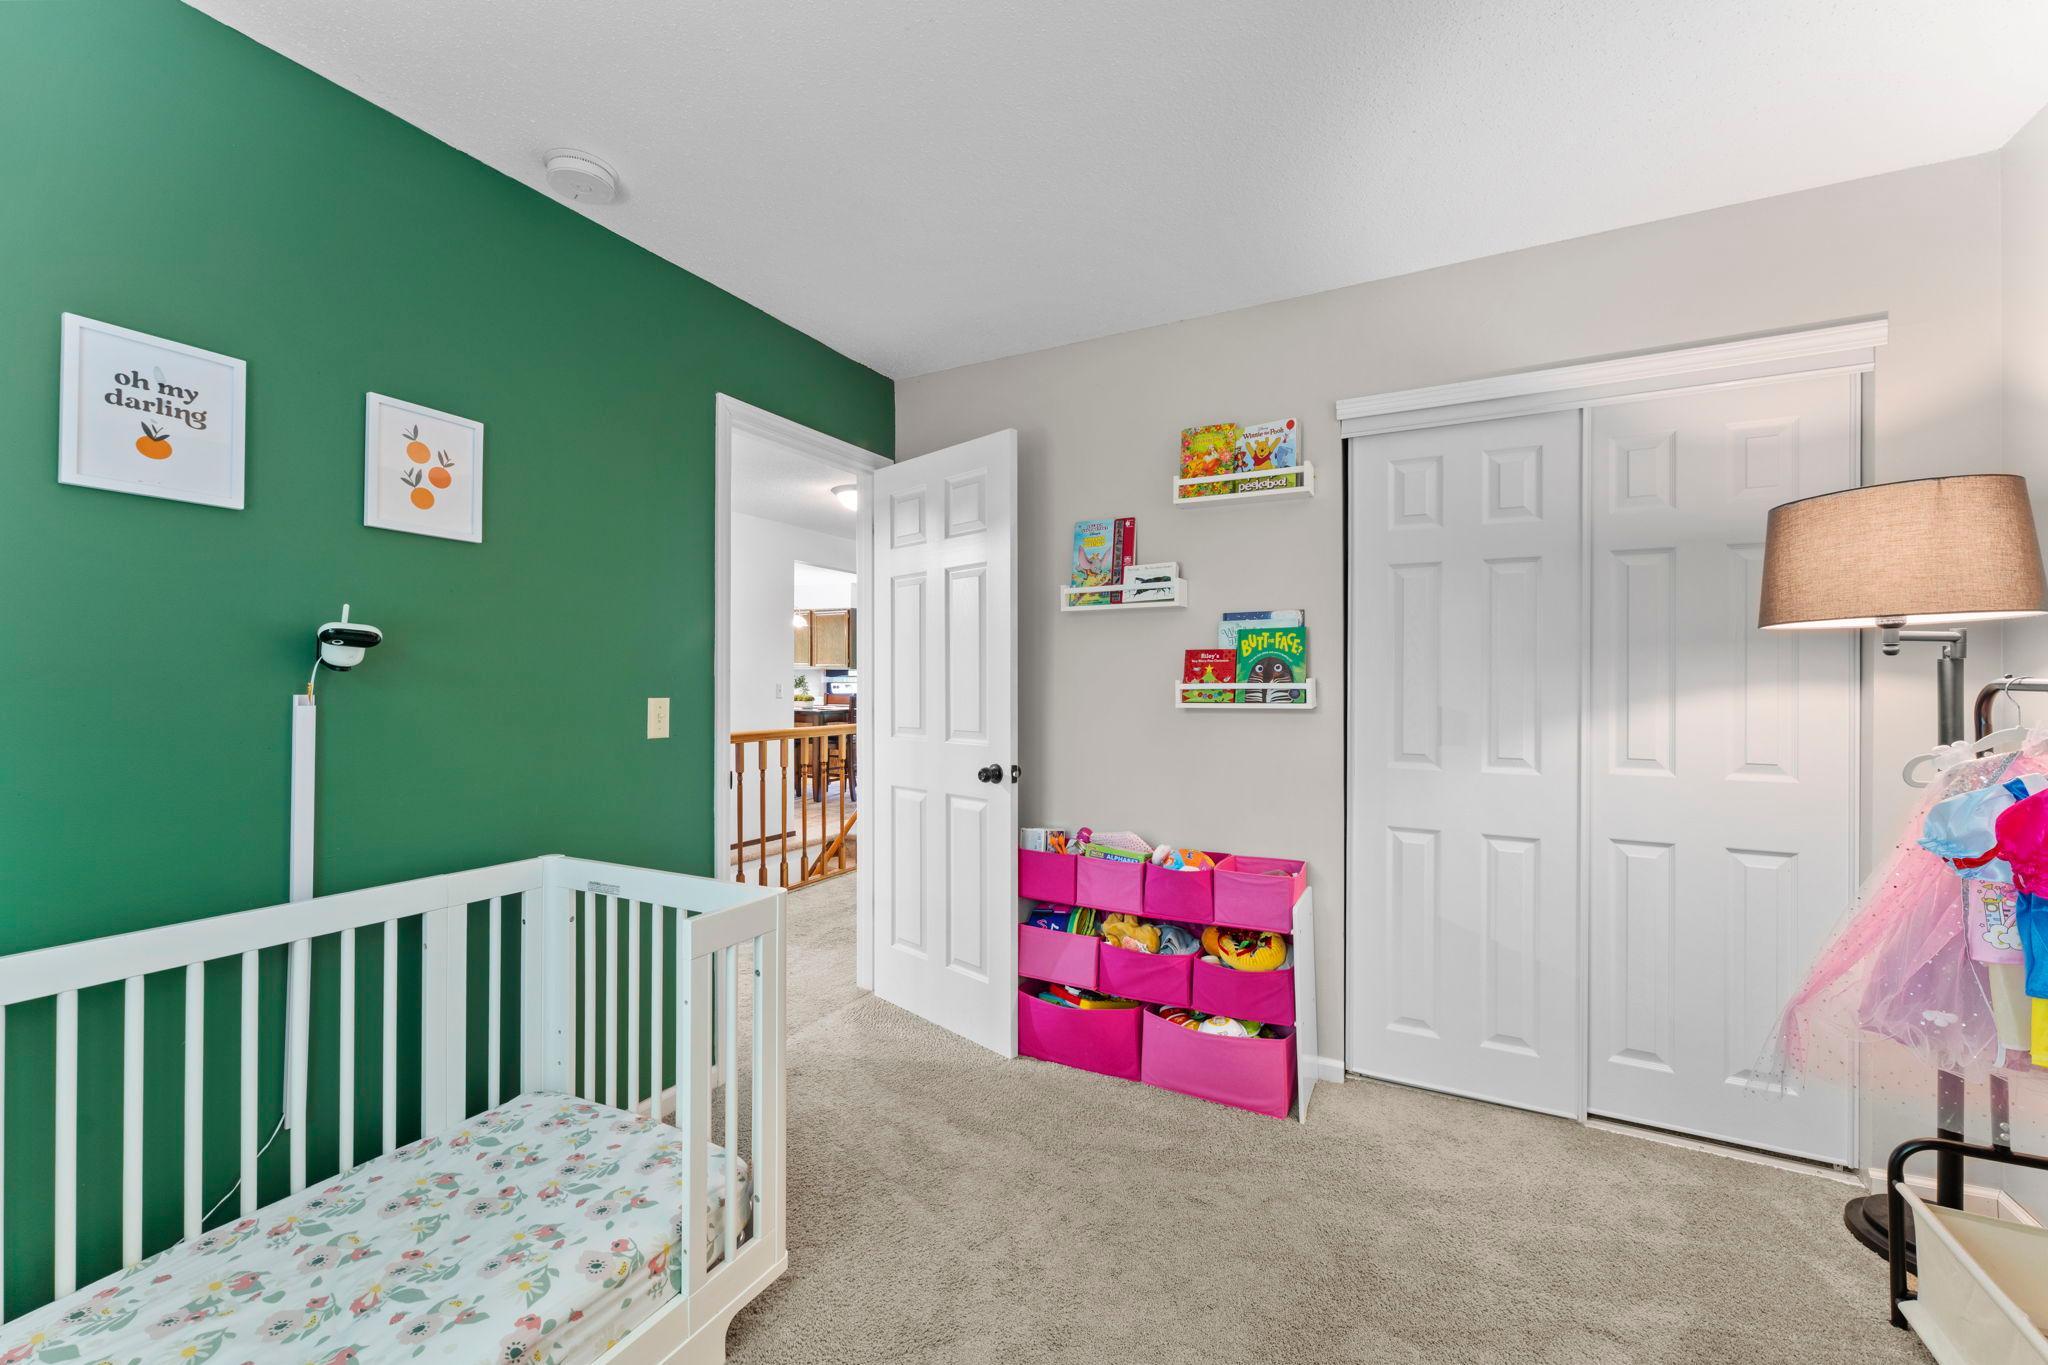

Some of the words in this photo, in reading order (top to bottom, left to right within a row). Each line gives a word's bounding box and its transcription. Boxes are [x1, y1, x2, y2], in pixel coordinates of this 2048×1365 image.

[114, 370, 150, 391] oh
[158, 382, 199, 406] my
[104, 388, 208, 431] darling
[1270, 426, 1284, 435] Pooh
[1239, 478, 1286, 493] peekaboo!
